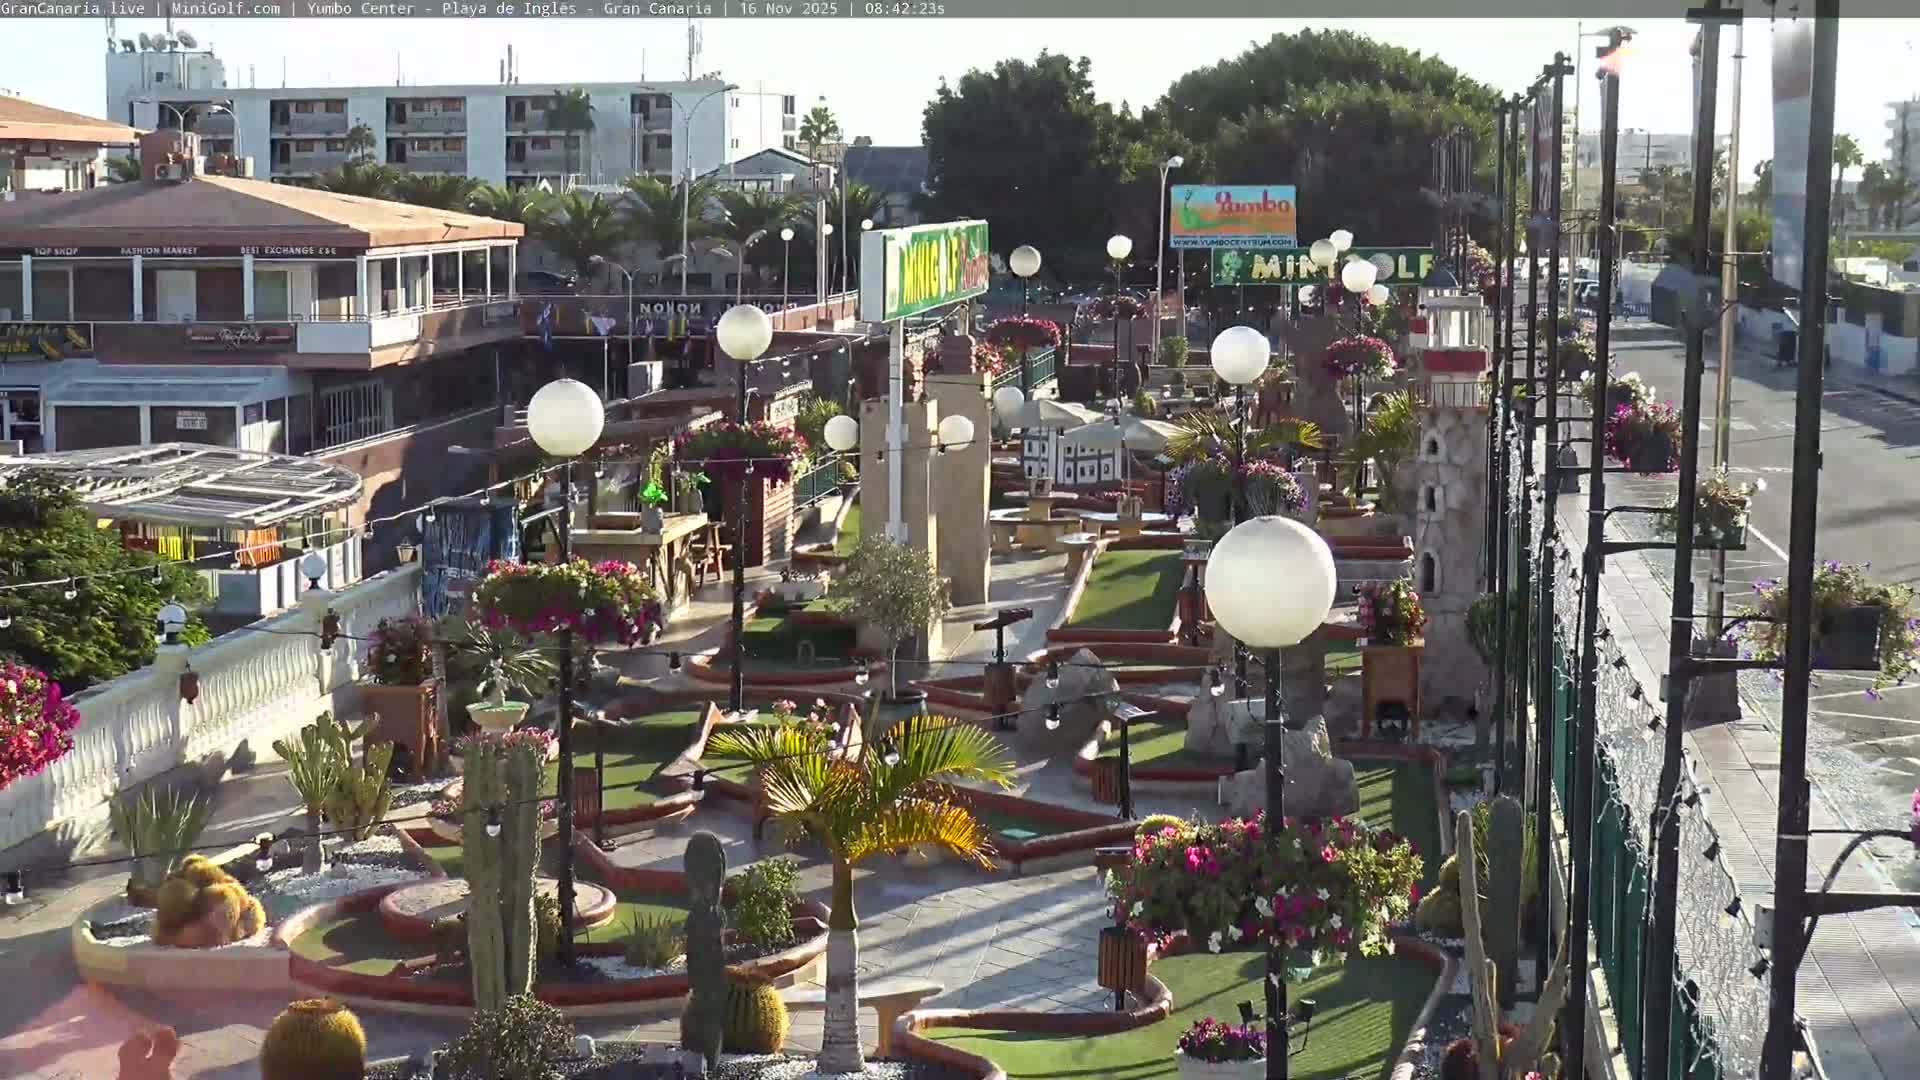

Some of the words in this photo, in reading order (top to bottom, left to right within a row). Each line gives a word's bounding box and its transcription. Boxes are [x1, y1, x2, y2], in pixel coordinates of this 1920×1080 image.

[1215, 189, 1290, 216] Yumbo
[120, 247, 160, 255] FASHION
[162, 247, 198, 255] MARKET
[240, 246, 260, 255] BEST
[264, 246, 315, 255] EXCHANGE
